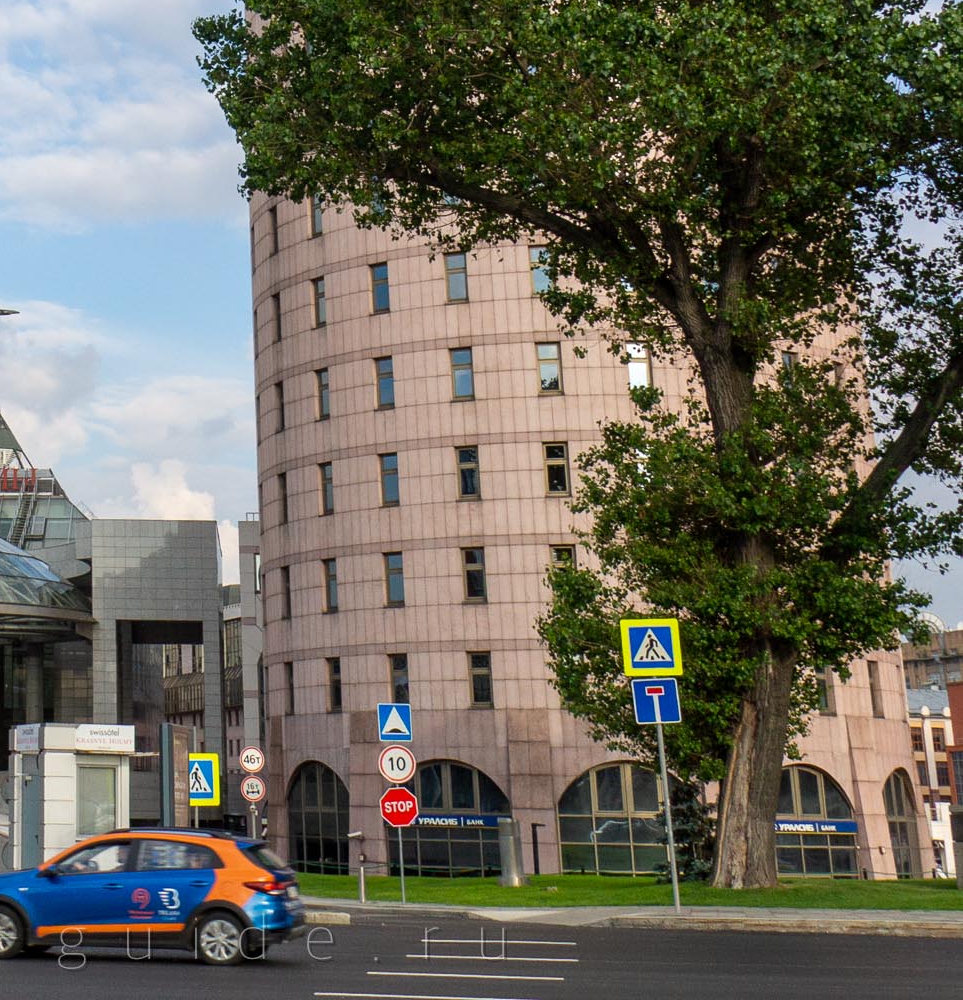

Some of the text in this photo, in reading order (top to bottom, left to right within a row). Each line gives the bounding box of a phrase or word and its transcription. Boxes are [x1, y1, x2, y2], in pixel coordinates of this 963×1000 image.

[388, 756, 406, 771] 10
[384, 801, 413, 813] STOP
[418, 817, 457, 826] УРАЛСИБ
